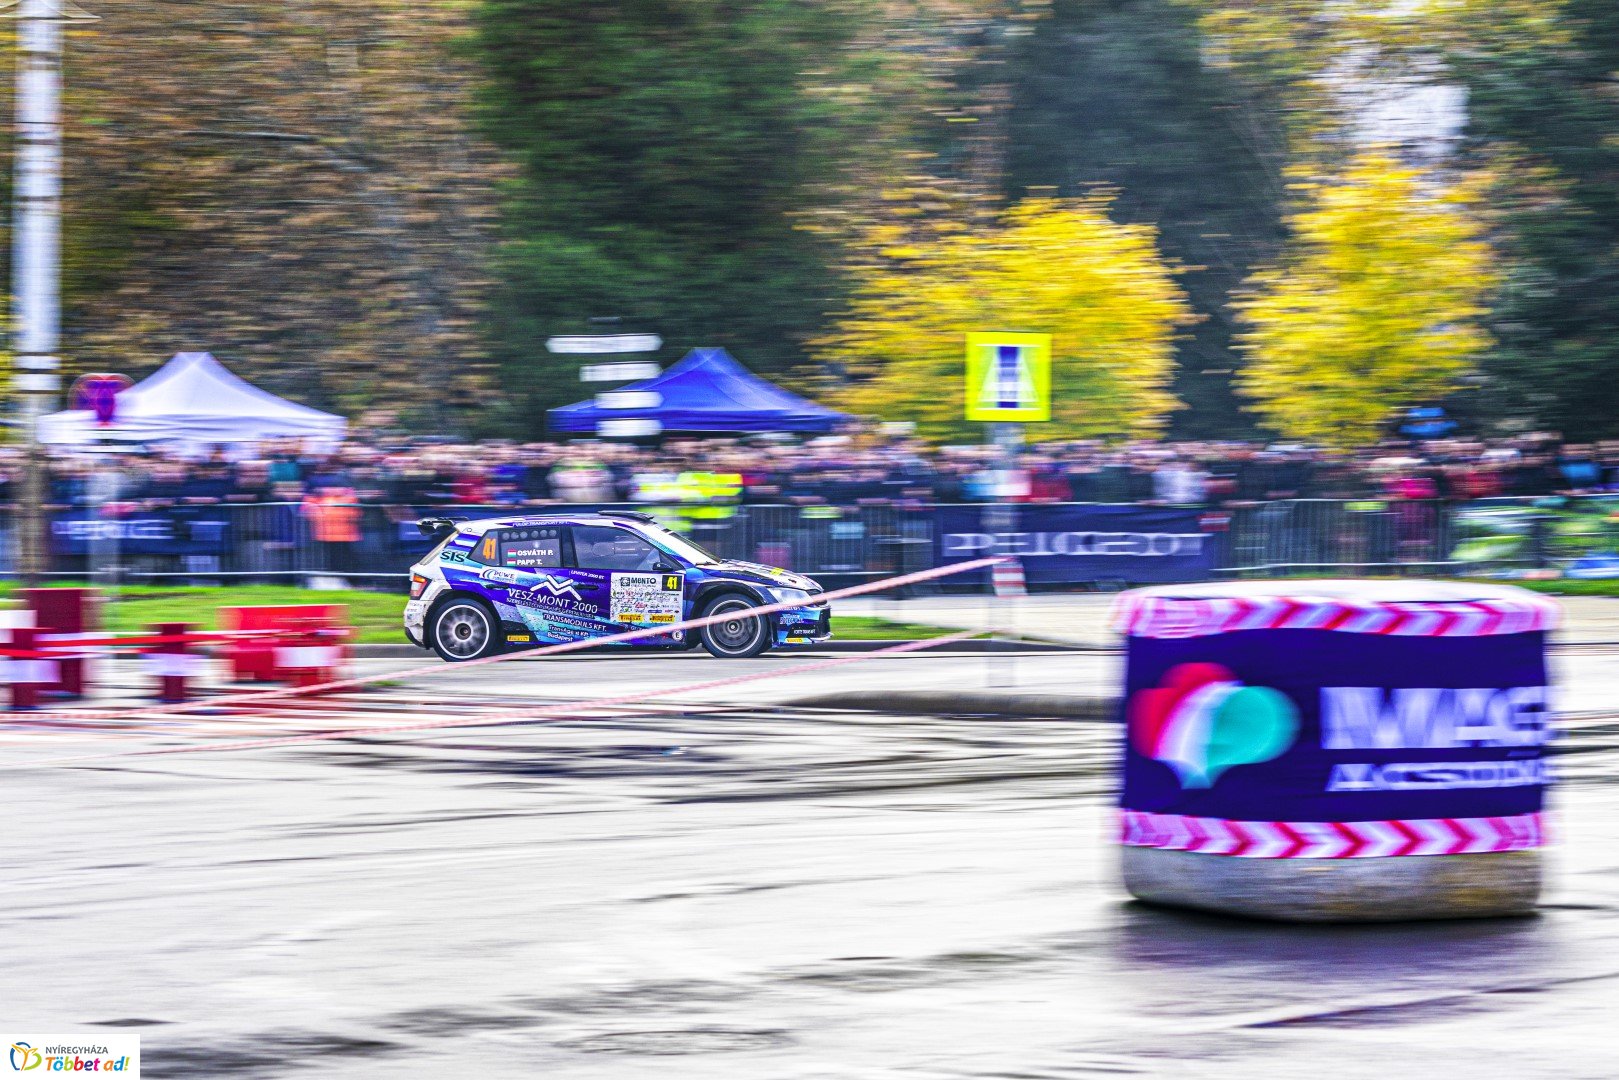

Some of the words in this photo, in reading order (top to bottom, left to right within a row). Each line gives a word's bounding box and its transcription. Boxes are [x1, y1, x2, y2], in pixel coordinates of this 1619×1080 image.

[482, 538, 497, 560] 41
[440, 550, 466, 562] SIS
[666, 576, 678, 590] 41
[507, 588, 570, 608] VESZ-MONT
[572, 600, 598, 614] 2000
[593, 624, 607, 632] KFT.
[547, 632, 574, 642] Budapest
